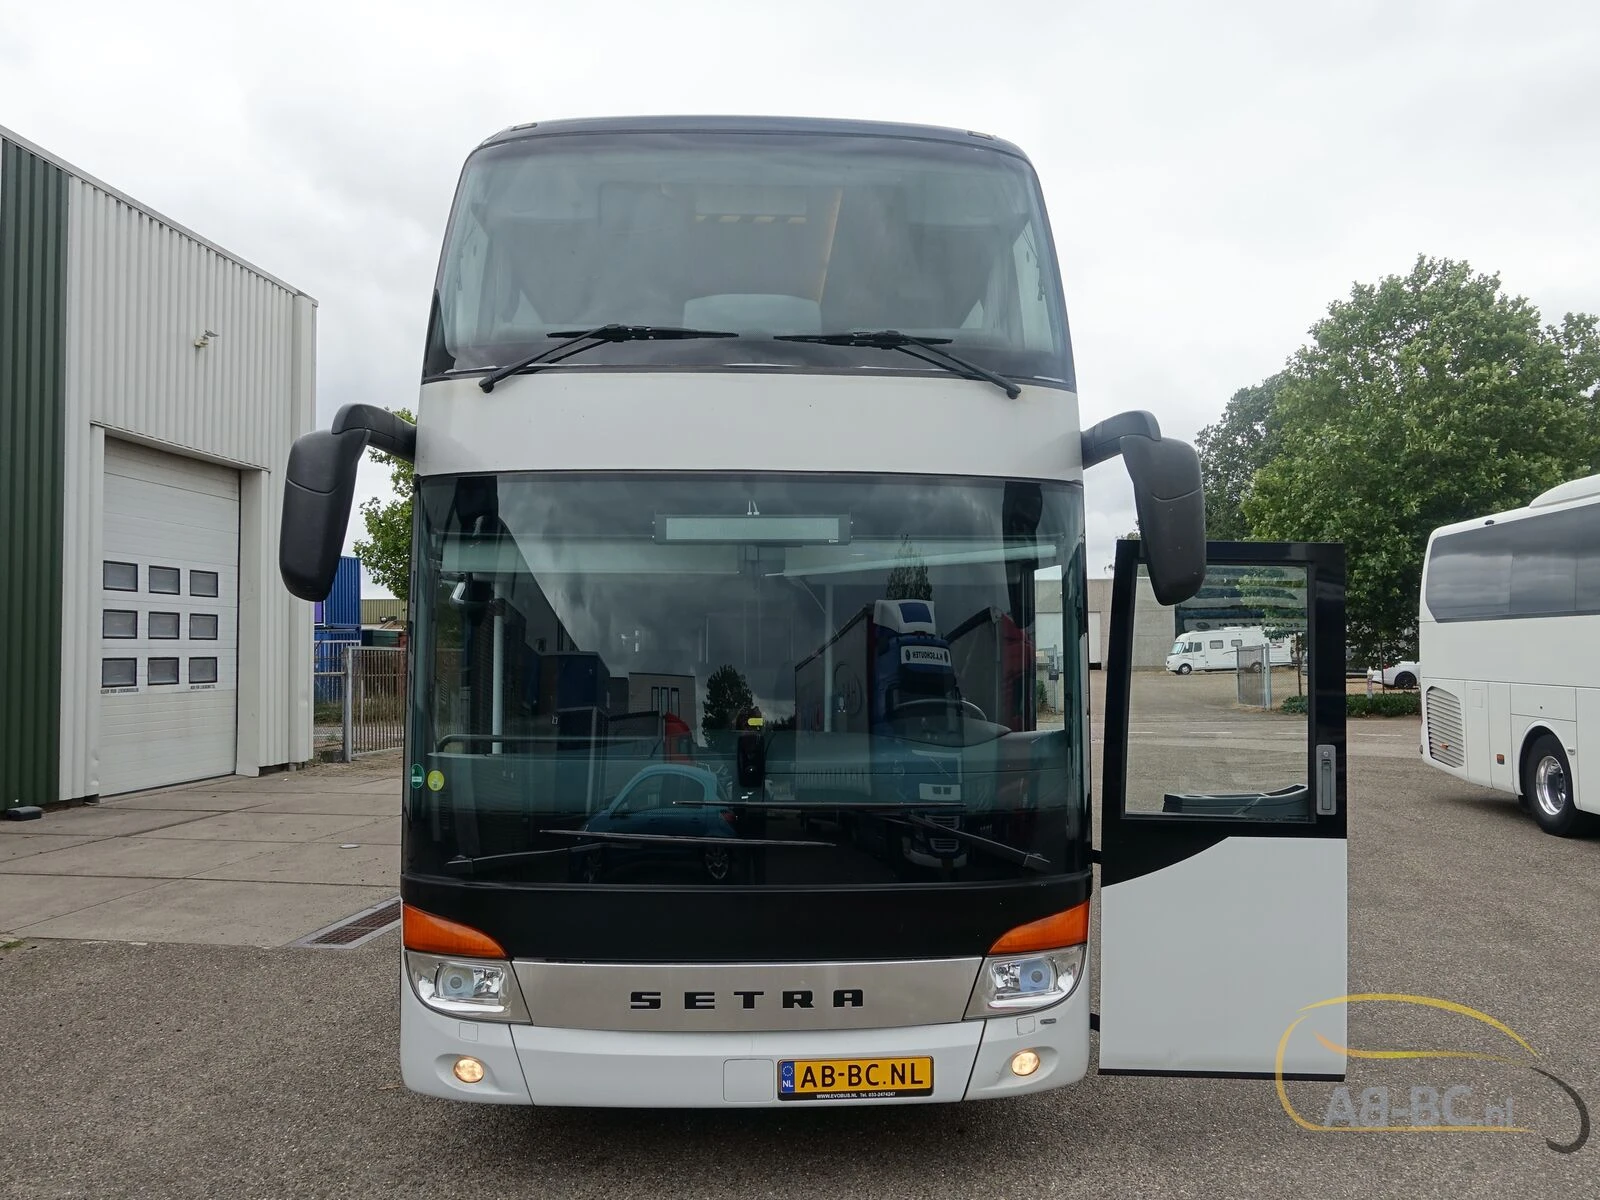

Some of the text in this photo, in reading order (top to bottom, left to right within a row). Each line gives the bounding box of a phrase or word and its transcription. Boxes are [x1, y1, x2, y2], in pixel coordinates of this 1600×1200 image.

[630, 989, 864, 1010] SETRA
[782, 1080, 793, 1088] NL
[800, 1062, 924, 1088] AB-BC.NL
